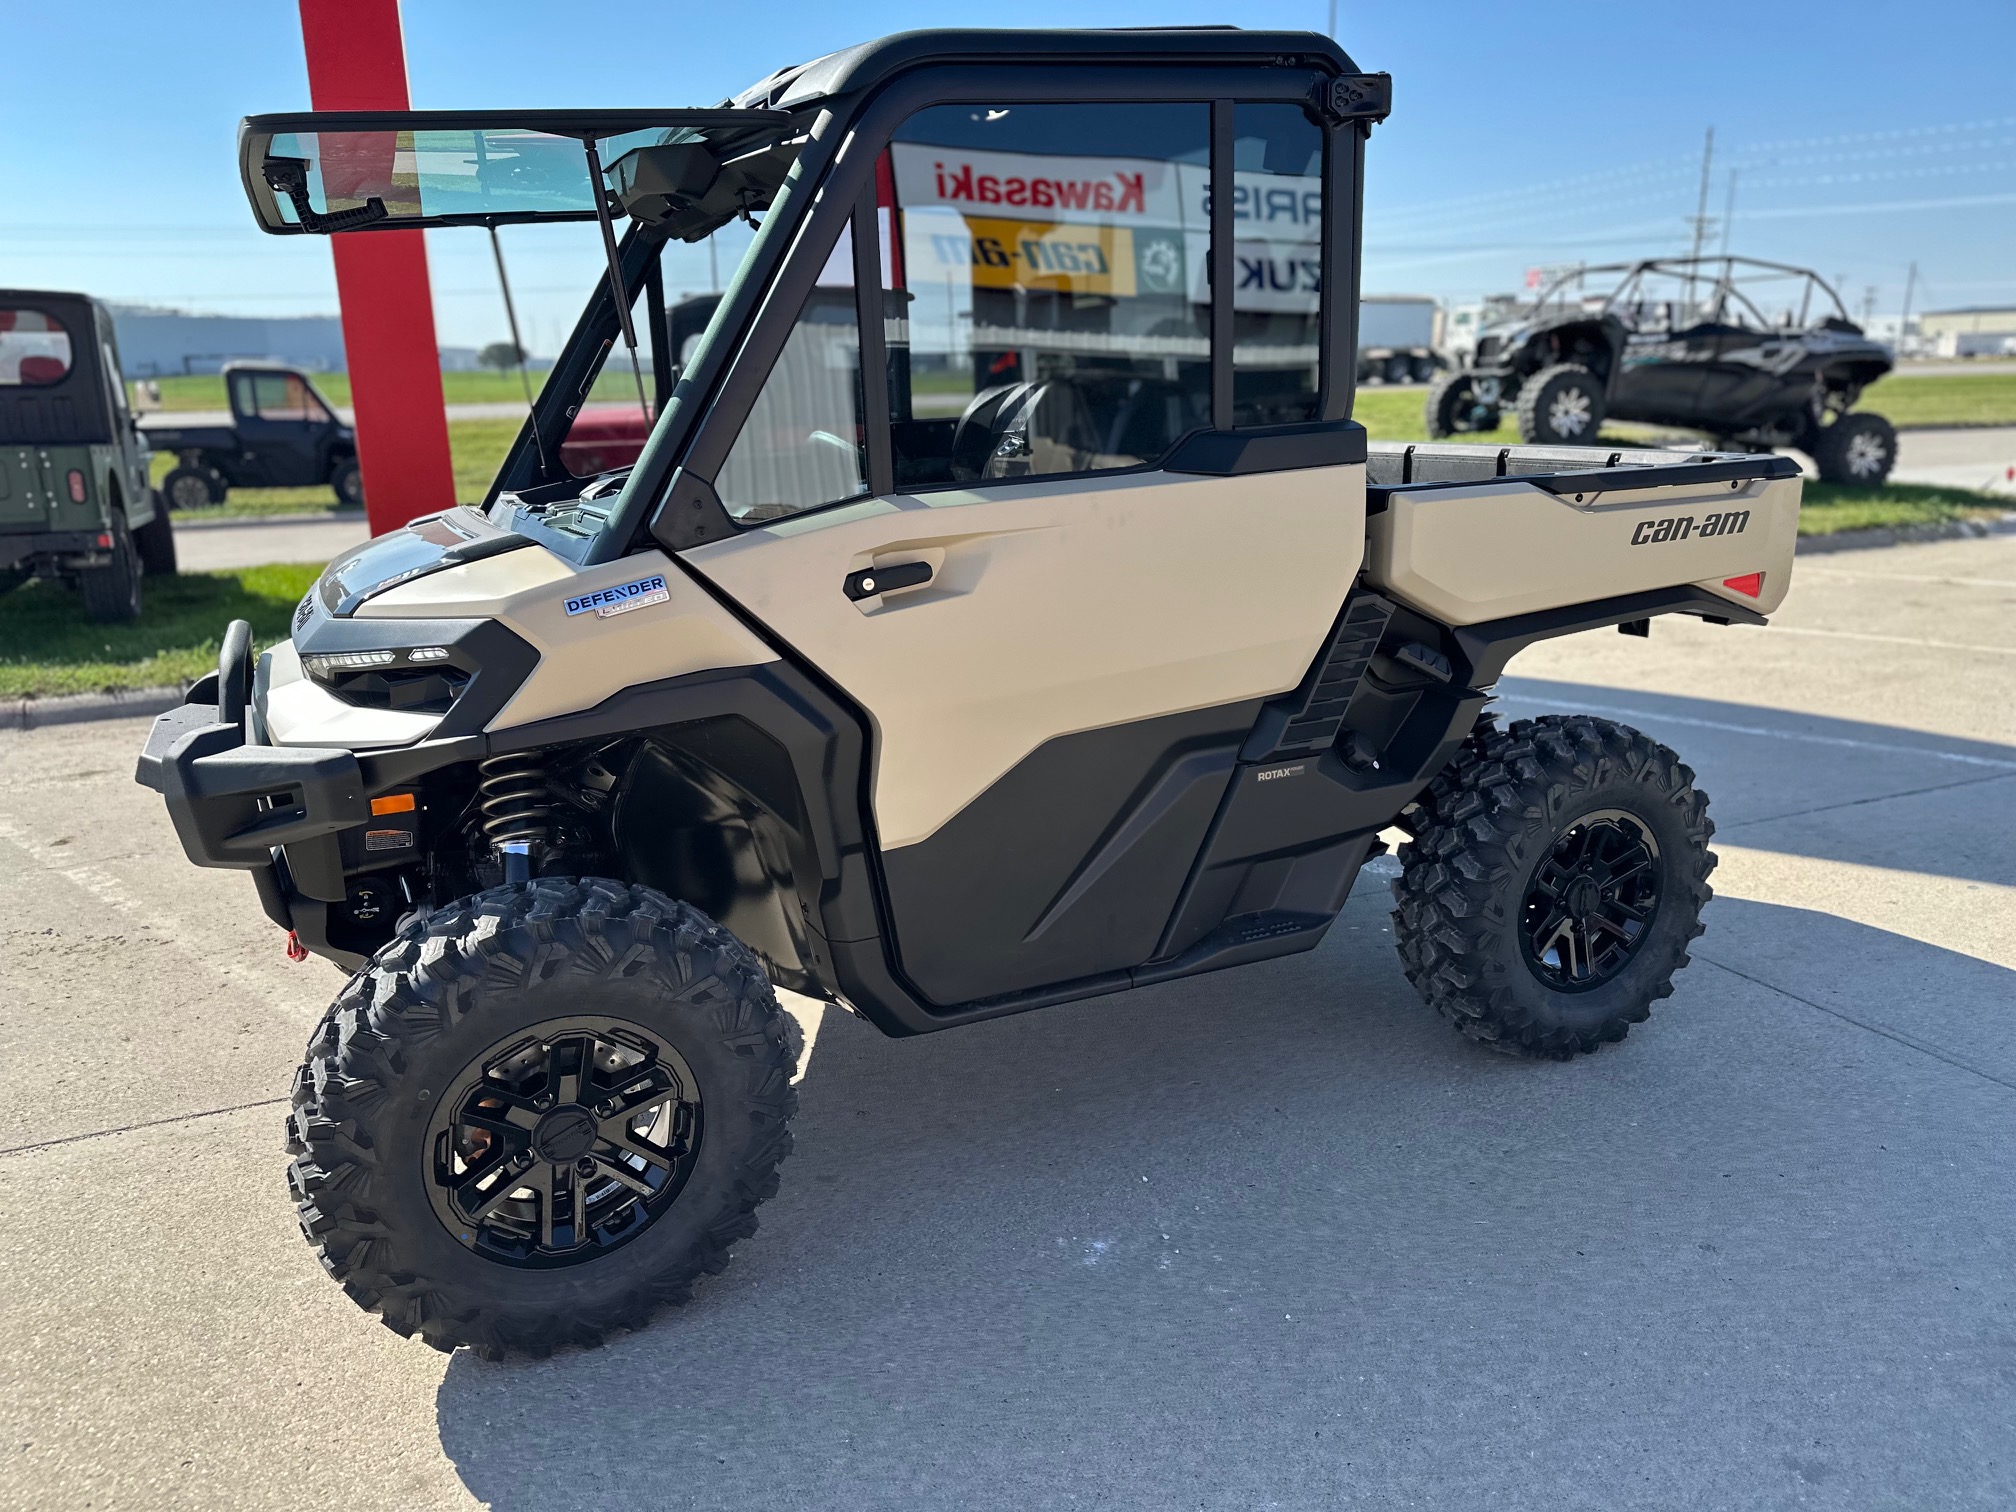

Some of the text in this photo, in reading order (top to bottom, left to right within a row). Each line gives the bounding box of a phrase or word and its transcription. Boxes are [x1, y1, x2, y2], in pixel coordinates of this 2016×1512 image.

[1631, 510, 1751, 546] can-am
[567, 577, 664, 612] DEFENDER
[1257, 768, 1290, 782] ROTAX
